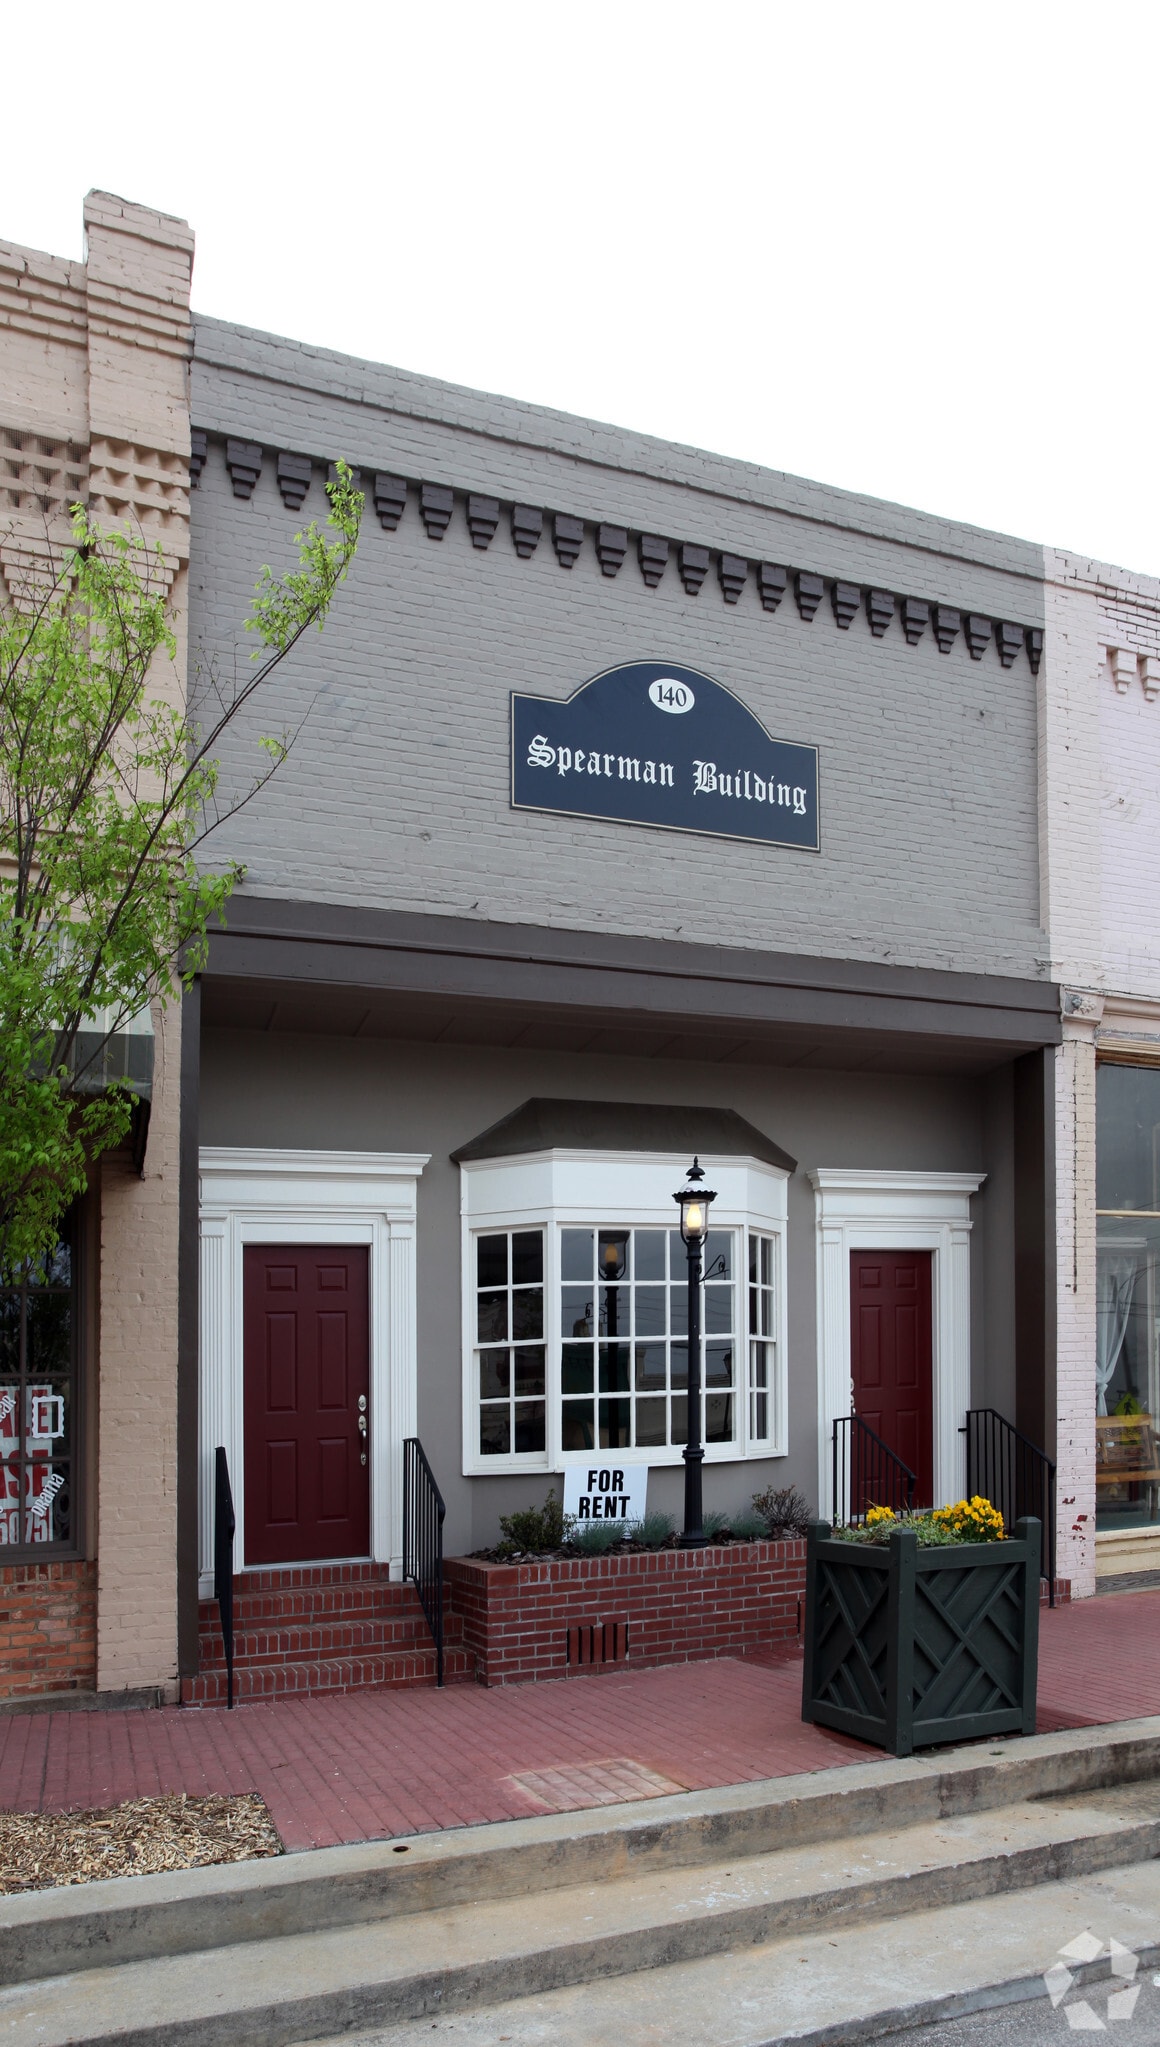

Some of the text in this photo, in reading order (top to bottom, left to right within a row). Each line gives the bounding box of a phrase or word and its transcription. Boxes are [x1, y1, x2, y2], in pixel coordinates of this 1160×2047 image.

[656, 684, 687, 707] 140
[527, 734, 807, 815] Spearman Building
[587, 1469, 624, 1493] FOR
[578, 1496, 631, 1519] RENT
